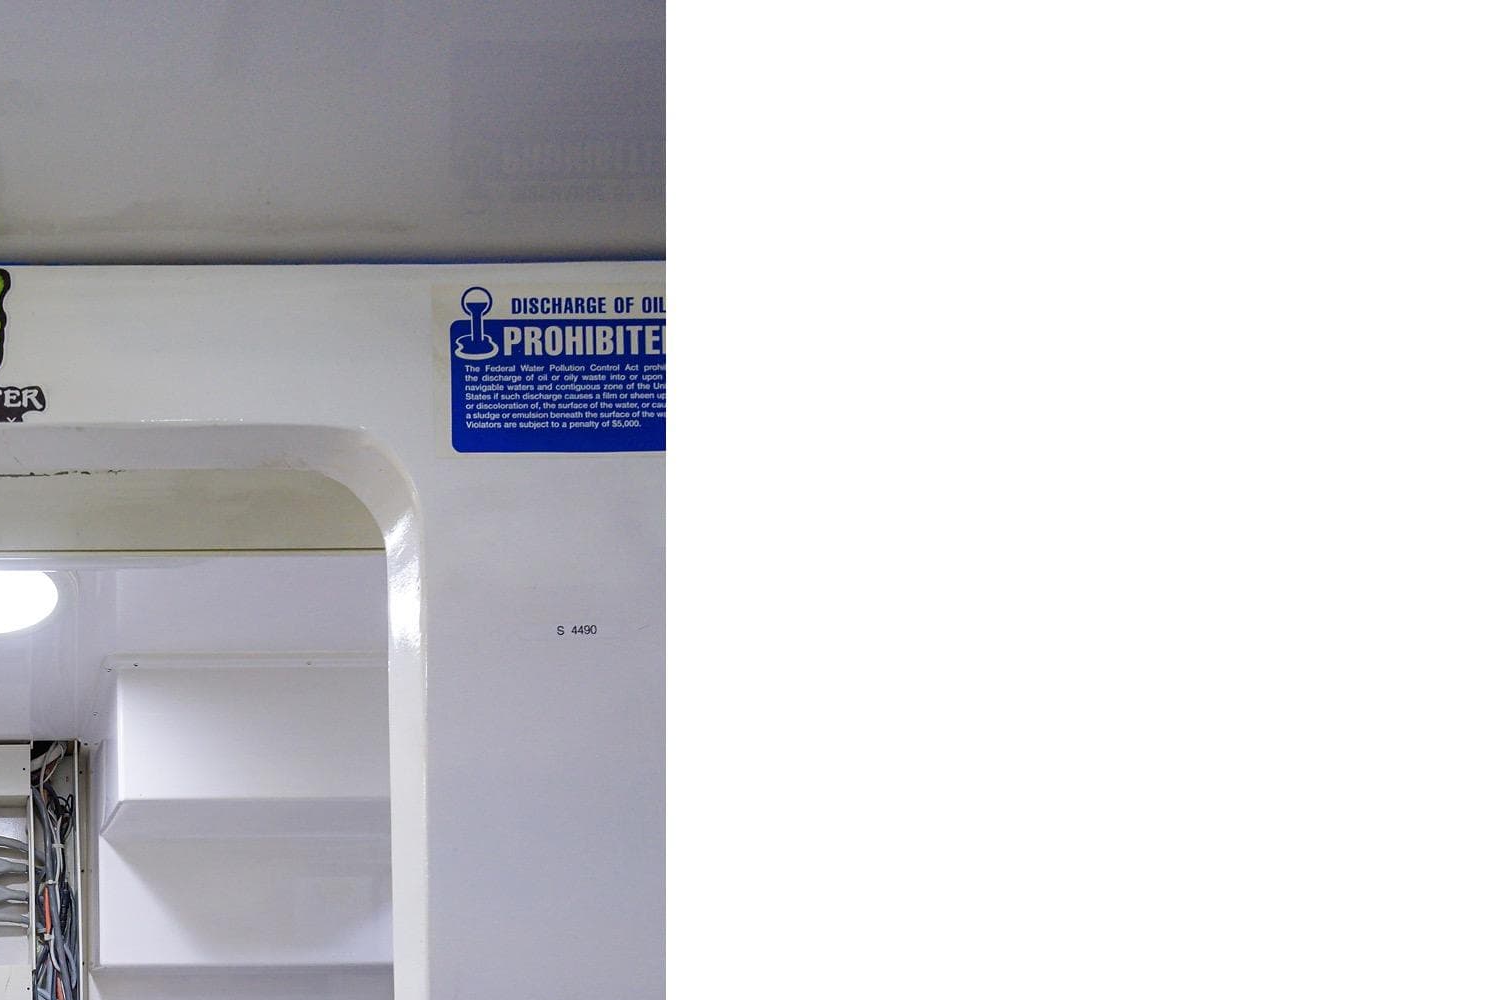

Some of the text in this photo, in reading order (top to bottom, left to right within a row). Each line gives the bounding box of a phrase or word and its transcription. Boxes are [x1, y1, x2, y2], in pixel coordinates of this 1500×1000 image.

[511, 296, 666, 314] DISCHARGE OF OIL
[503, 325, 666, 356] PROHIBITE
[464, 364, 480, 372] The
[485, 364, 516, 372] Federal
[520, 364, 544, 372] Water
[549, 364, 585, 372] Pollution
[590, 364, 620, 372] Control
[624, 363, 639, 371] Act
[465, 374, 478, 382] the
[482, 374, 522, 383] discharge
[564, 374, 579, 382] oily
[465, 383, 504, 392] navigable
[537, 383, 553, 391] and
[555, 383, 601, 392] contiguous
[603, 383, 623, 391] zone
[637, 382, 651, 390] the
[522, 392, 562, 402] discharge
[476, 402, 529, 410] discoloration
[530, 402, 542, 411] of,
[615, 402, 640, 410] water,
[473, 412, 500, 420] sludge
[550, 411, 583, 419] beneath
[600, 410, 630, 418] surface
[632, 410, 640, 418] of
[466, 421, 502, 429] Violators
[519, 421, 549, 430] subject
[569, 420, 599, 430] penalty
[601, 420, 610, 428] of
[612, 420, 642, 428] $5,000.
[556, 624, 598, 636] S 4490
